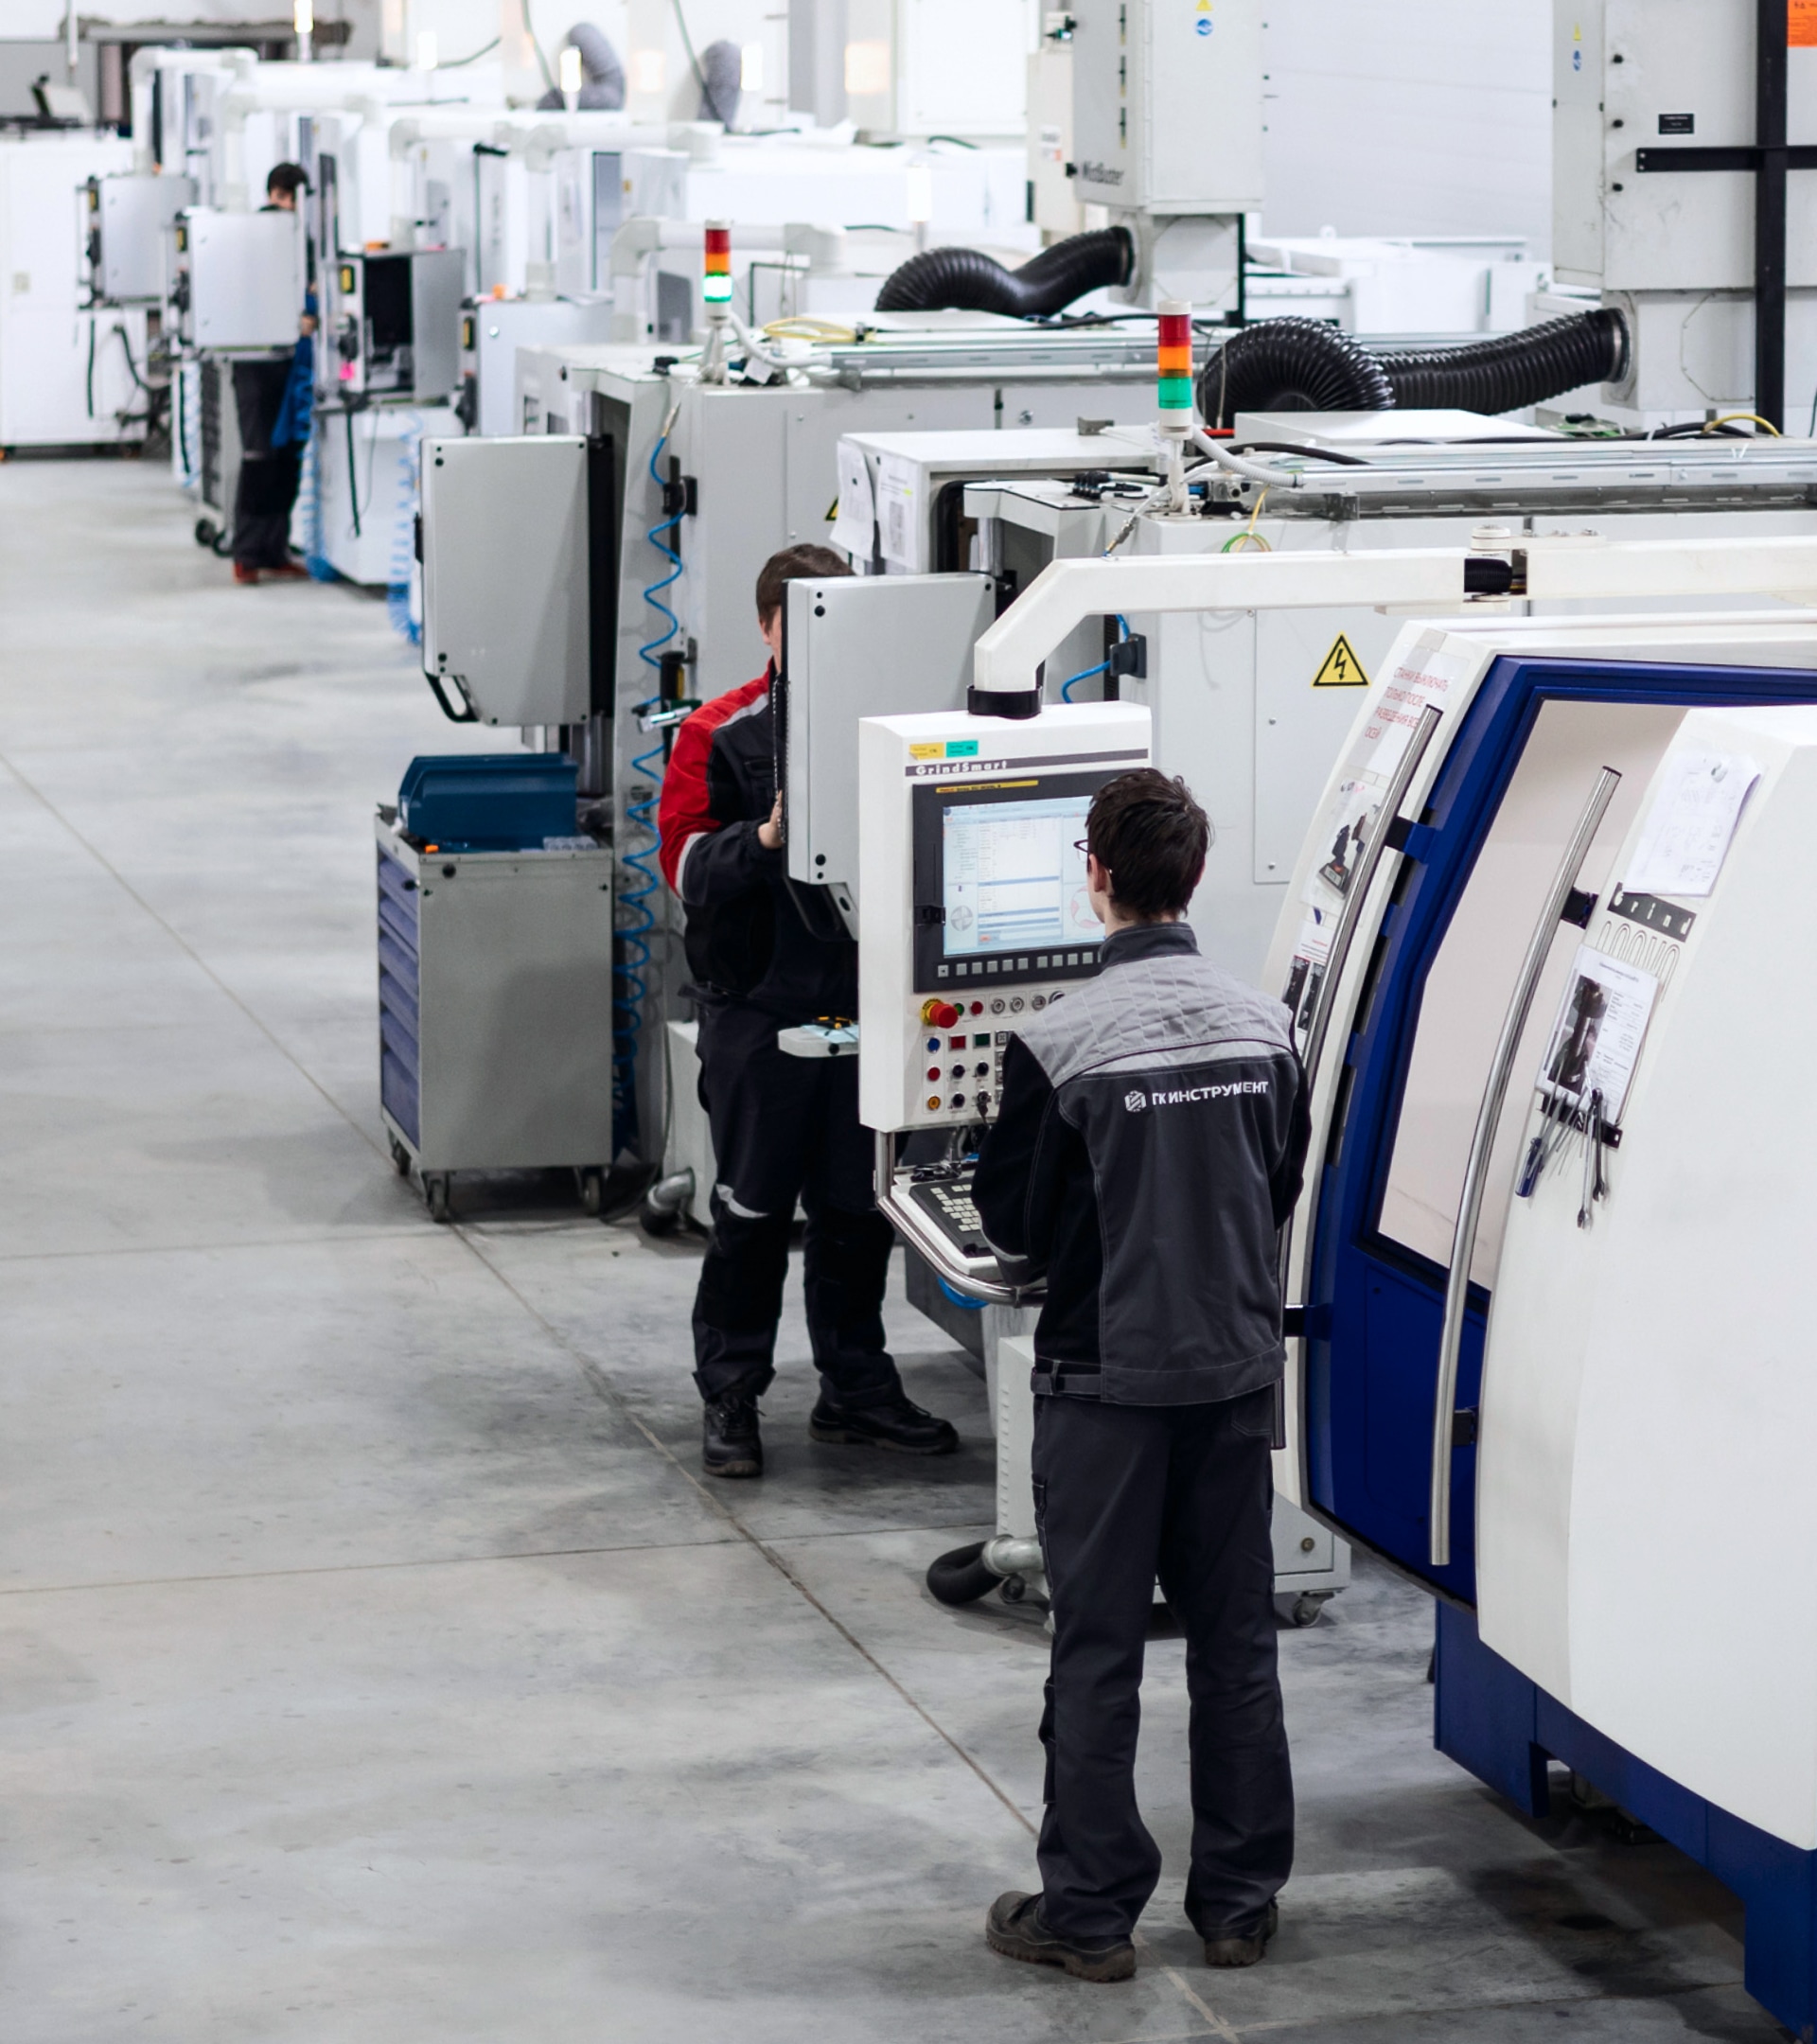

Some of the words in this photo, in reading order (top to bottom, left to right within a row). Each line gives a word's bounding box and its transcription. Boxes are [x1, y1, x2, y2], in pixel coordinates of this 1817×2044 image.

[915, 760, 1008, 775] GrindSmart
[1614, 890, 1692, 935] Grind
[1168, 1081, 1269, 1104] ИНСТРУМЕНТ
